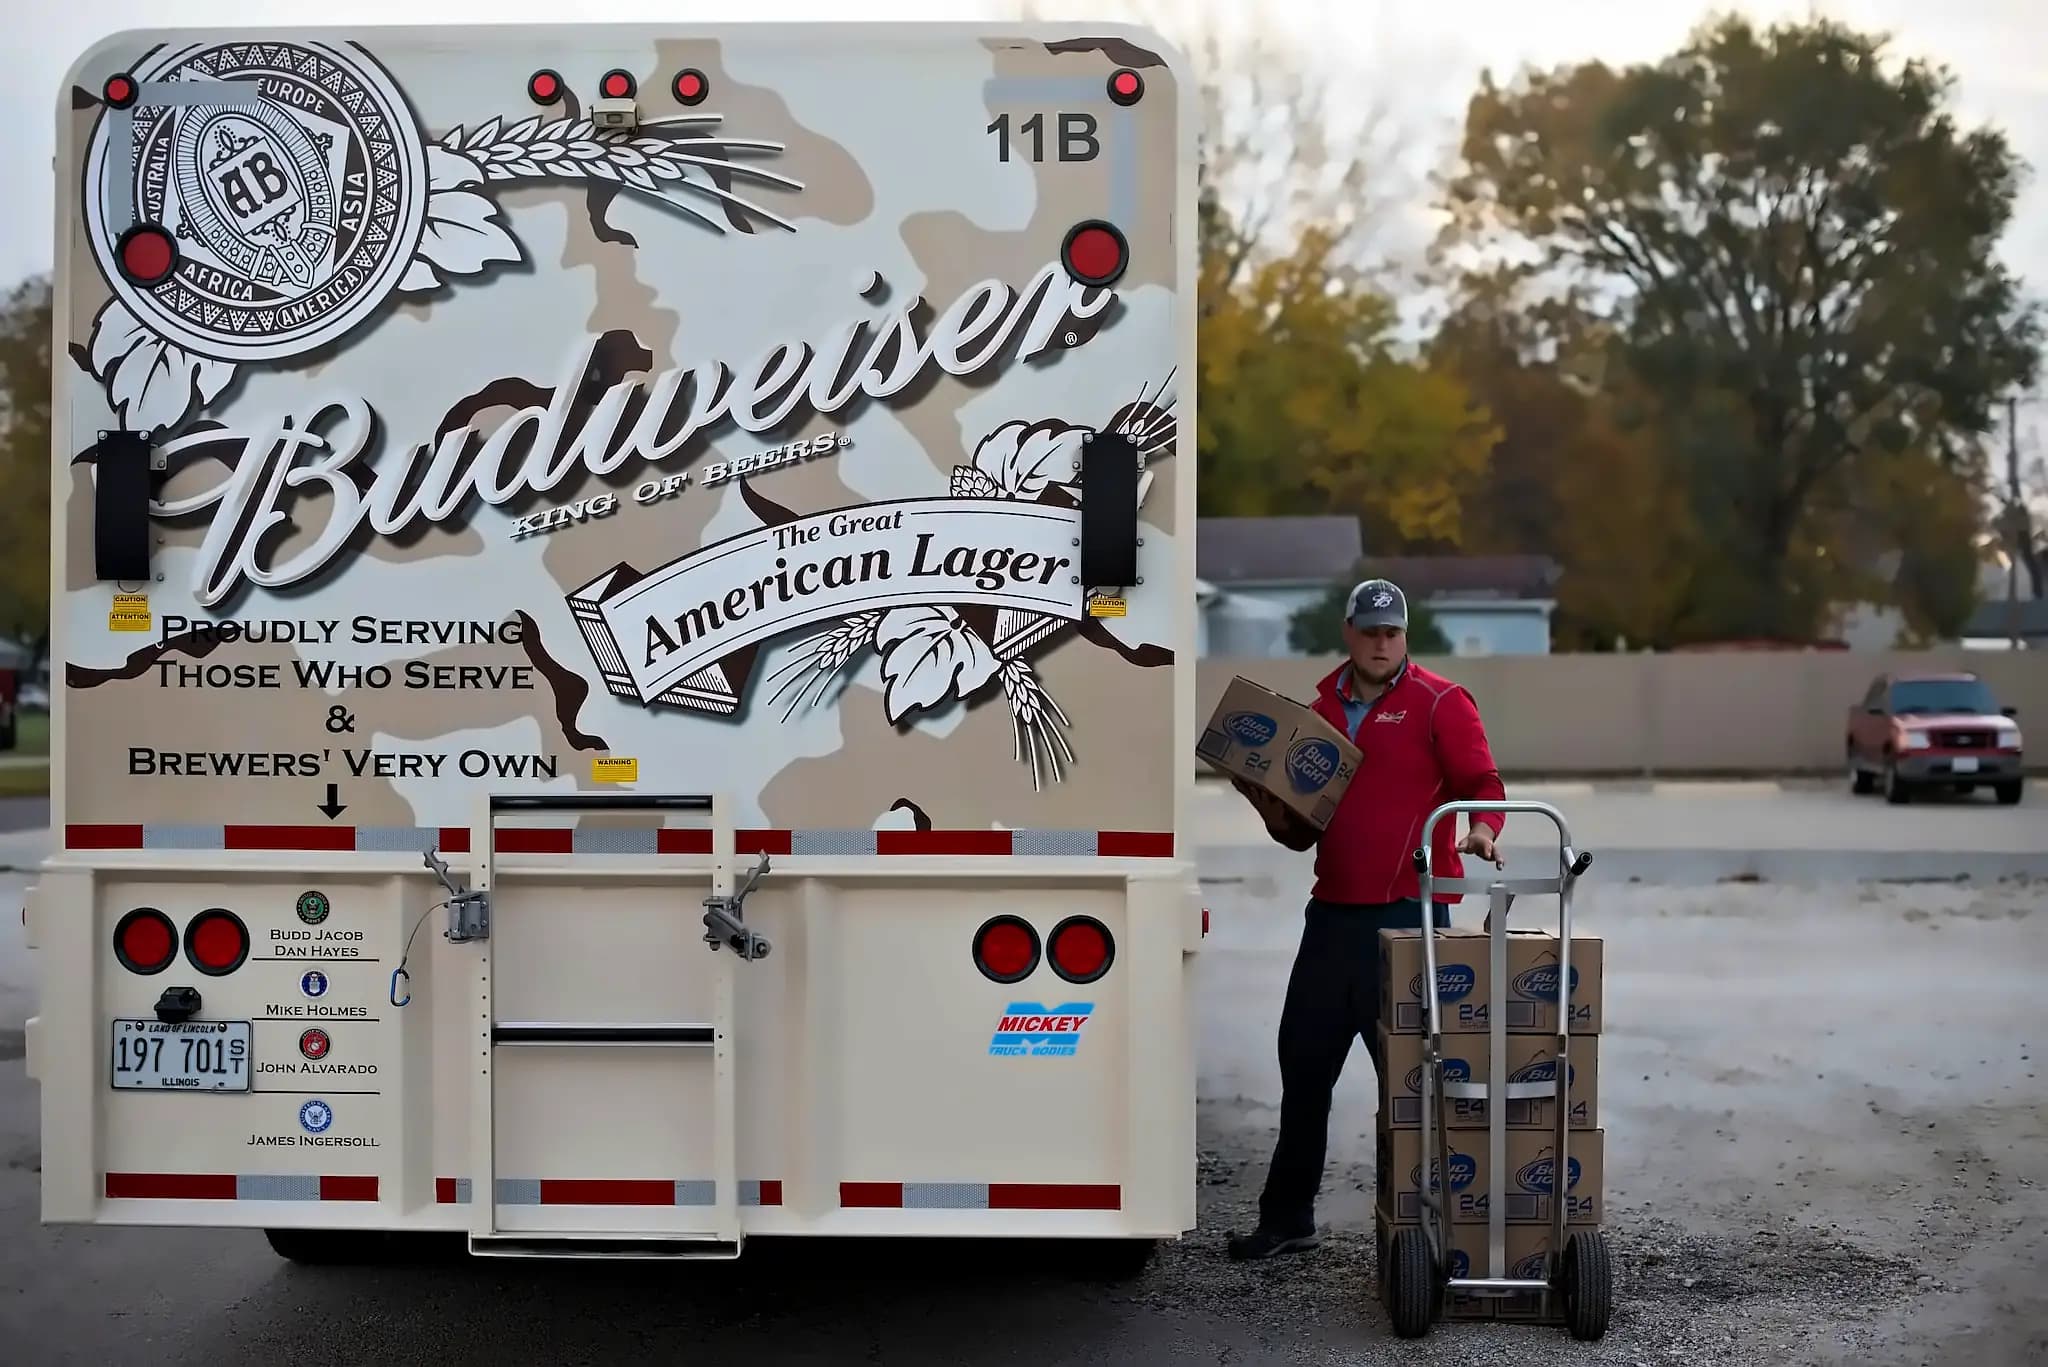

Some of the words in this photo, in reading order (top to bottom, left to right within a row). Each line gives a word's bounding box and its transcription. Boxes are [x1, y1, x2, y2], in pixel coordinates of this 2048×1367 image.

[258, 78, 325, 113] EUROPE
[986, 113, 1100, 163] 11B
[147, 136, 170, 222] AUSTRALIA
[218, 151, 288, 219] AB
[341, 171, 366, 232] ASIA
[184, 263, 254, 301] AFRICA
[281, 271, 360, 326] AMERICA
[150, 258, 1113, 607] Budweiser
[510, 493, 618, 538] KING
[632, 473, 689, 503] OF
[773, 526, 820, 551] The
[828, 510, 904, 537] Great
[644, 547, 892, 668] American
[907, 533, 1070, 591] Lager
[325, 704, 356, 734] &
[1245, 752, 1272, 771] 24
[1338, 763, 1354, 781] 24
[270, 930, 312, 940] BUDD
[314, 930, 364, 941] JACOB
[275, 946, 307, 956] DAN
[311, 946, 359, 957] HAYES
[266, 1005, 303, 1015] MIKE
[307, 1005, 367, 1016] HOLMES
[1459, 1003, 1489, 1021] 24
[125, 1024, 132, 1032] P
[149, 1025, 170, 1033] LAND
[171, 1024, 182, 1032] OF
[182, 1024, 216, 1033] LINCOLN
[997, 1016, 1089, 1032] MICKEY
[117, 1037, 164, 1073] 197
[180, 1038, 227, 1074] 701
[989, 1047, 1028, 1056] TRUCK
[1031, 1047, 1076, 1056] BODIES
[256, 1062, 296, 1073] JOHN
[300, 1063, 378, 1074] ALVARADO
[162, 1078, 200, 1087] ILLINOIS
[1455, 1099, 1484, 1115] 24
[247, 1134, 296, 1146] JAMES
[299, 1136, 381, 1147] INGERSOLL
[1461, 1194, 1490, 1211] 24
